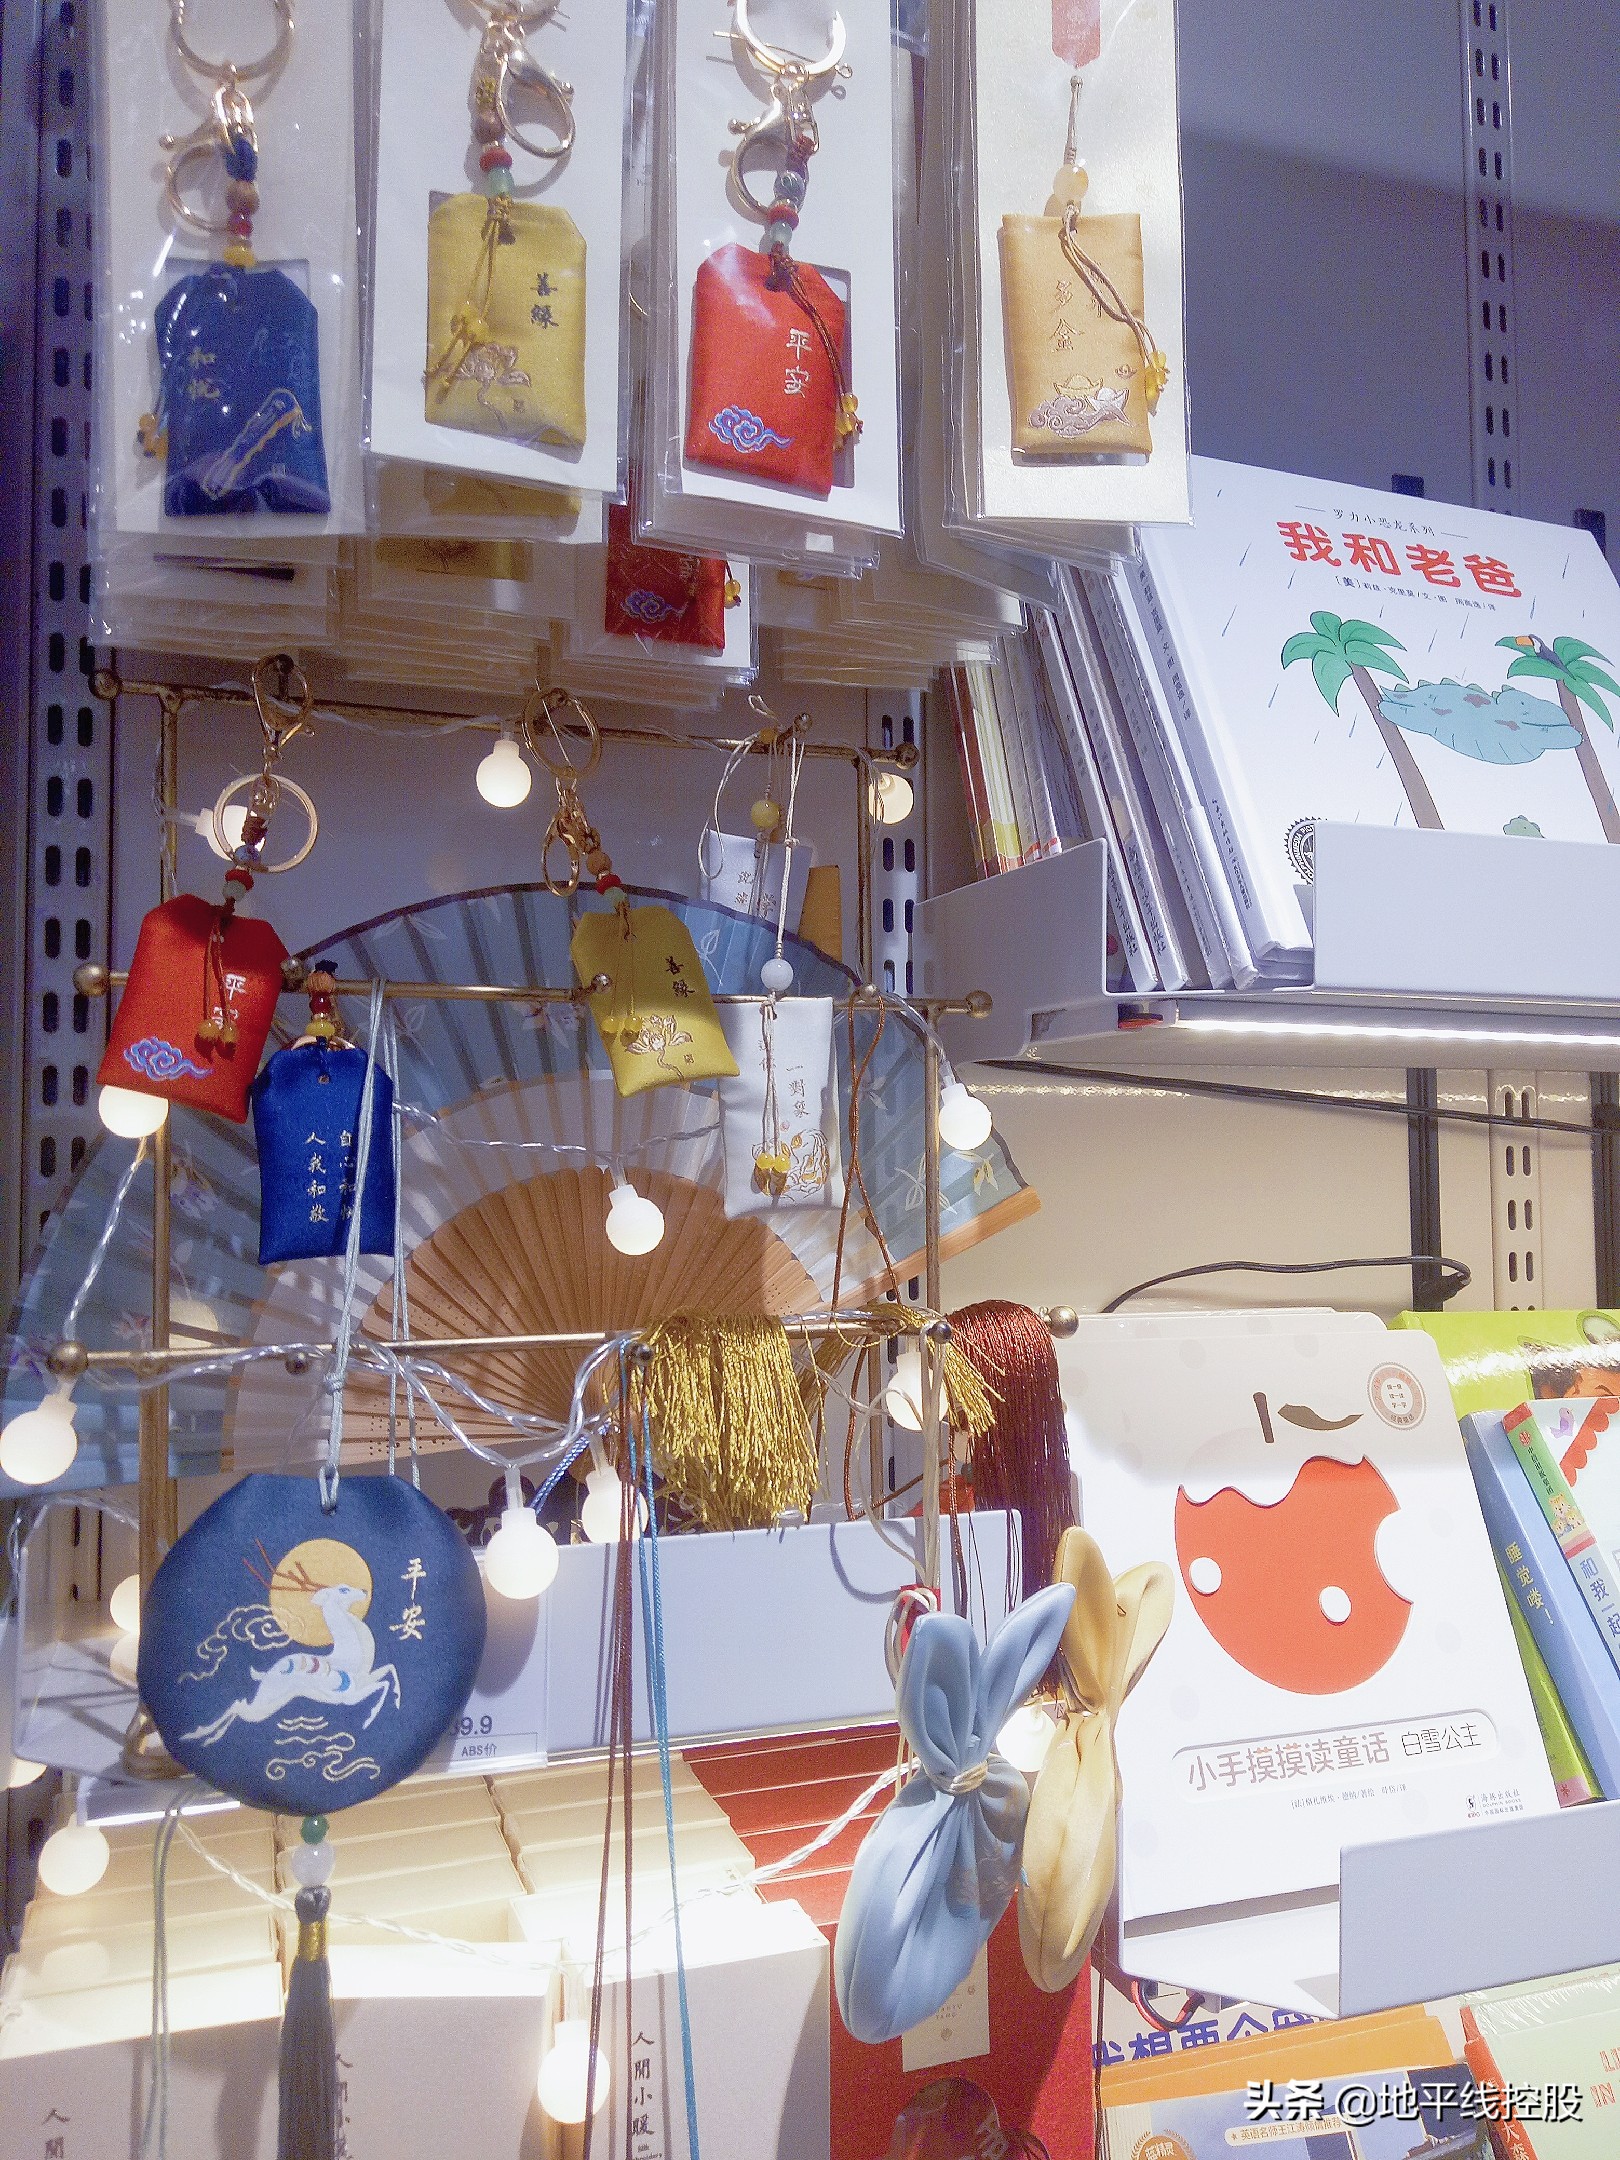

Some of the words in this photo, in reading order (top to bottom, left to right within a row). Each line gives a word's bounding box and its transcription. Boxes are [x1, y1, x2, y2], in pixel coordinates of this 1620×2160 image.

[783, 327, 813, 399] 平安
[1333, 508, 1436, 537] 罗力小恐龙系列
[1276, 521, 1522, 598] 我和老爸
[389, 1557, 427, 1641] 平安
[1188, 1731, 1390, 1792] 小手摸摸读童话
[1401, 1722, 1482, 1757] 白雪公主
